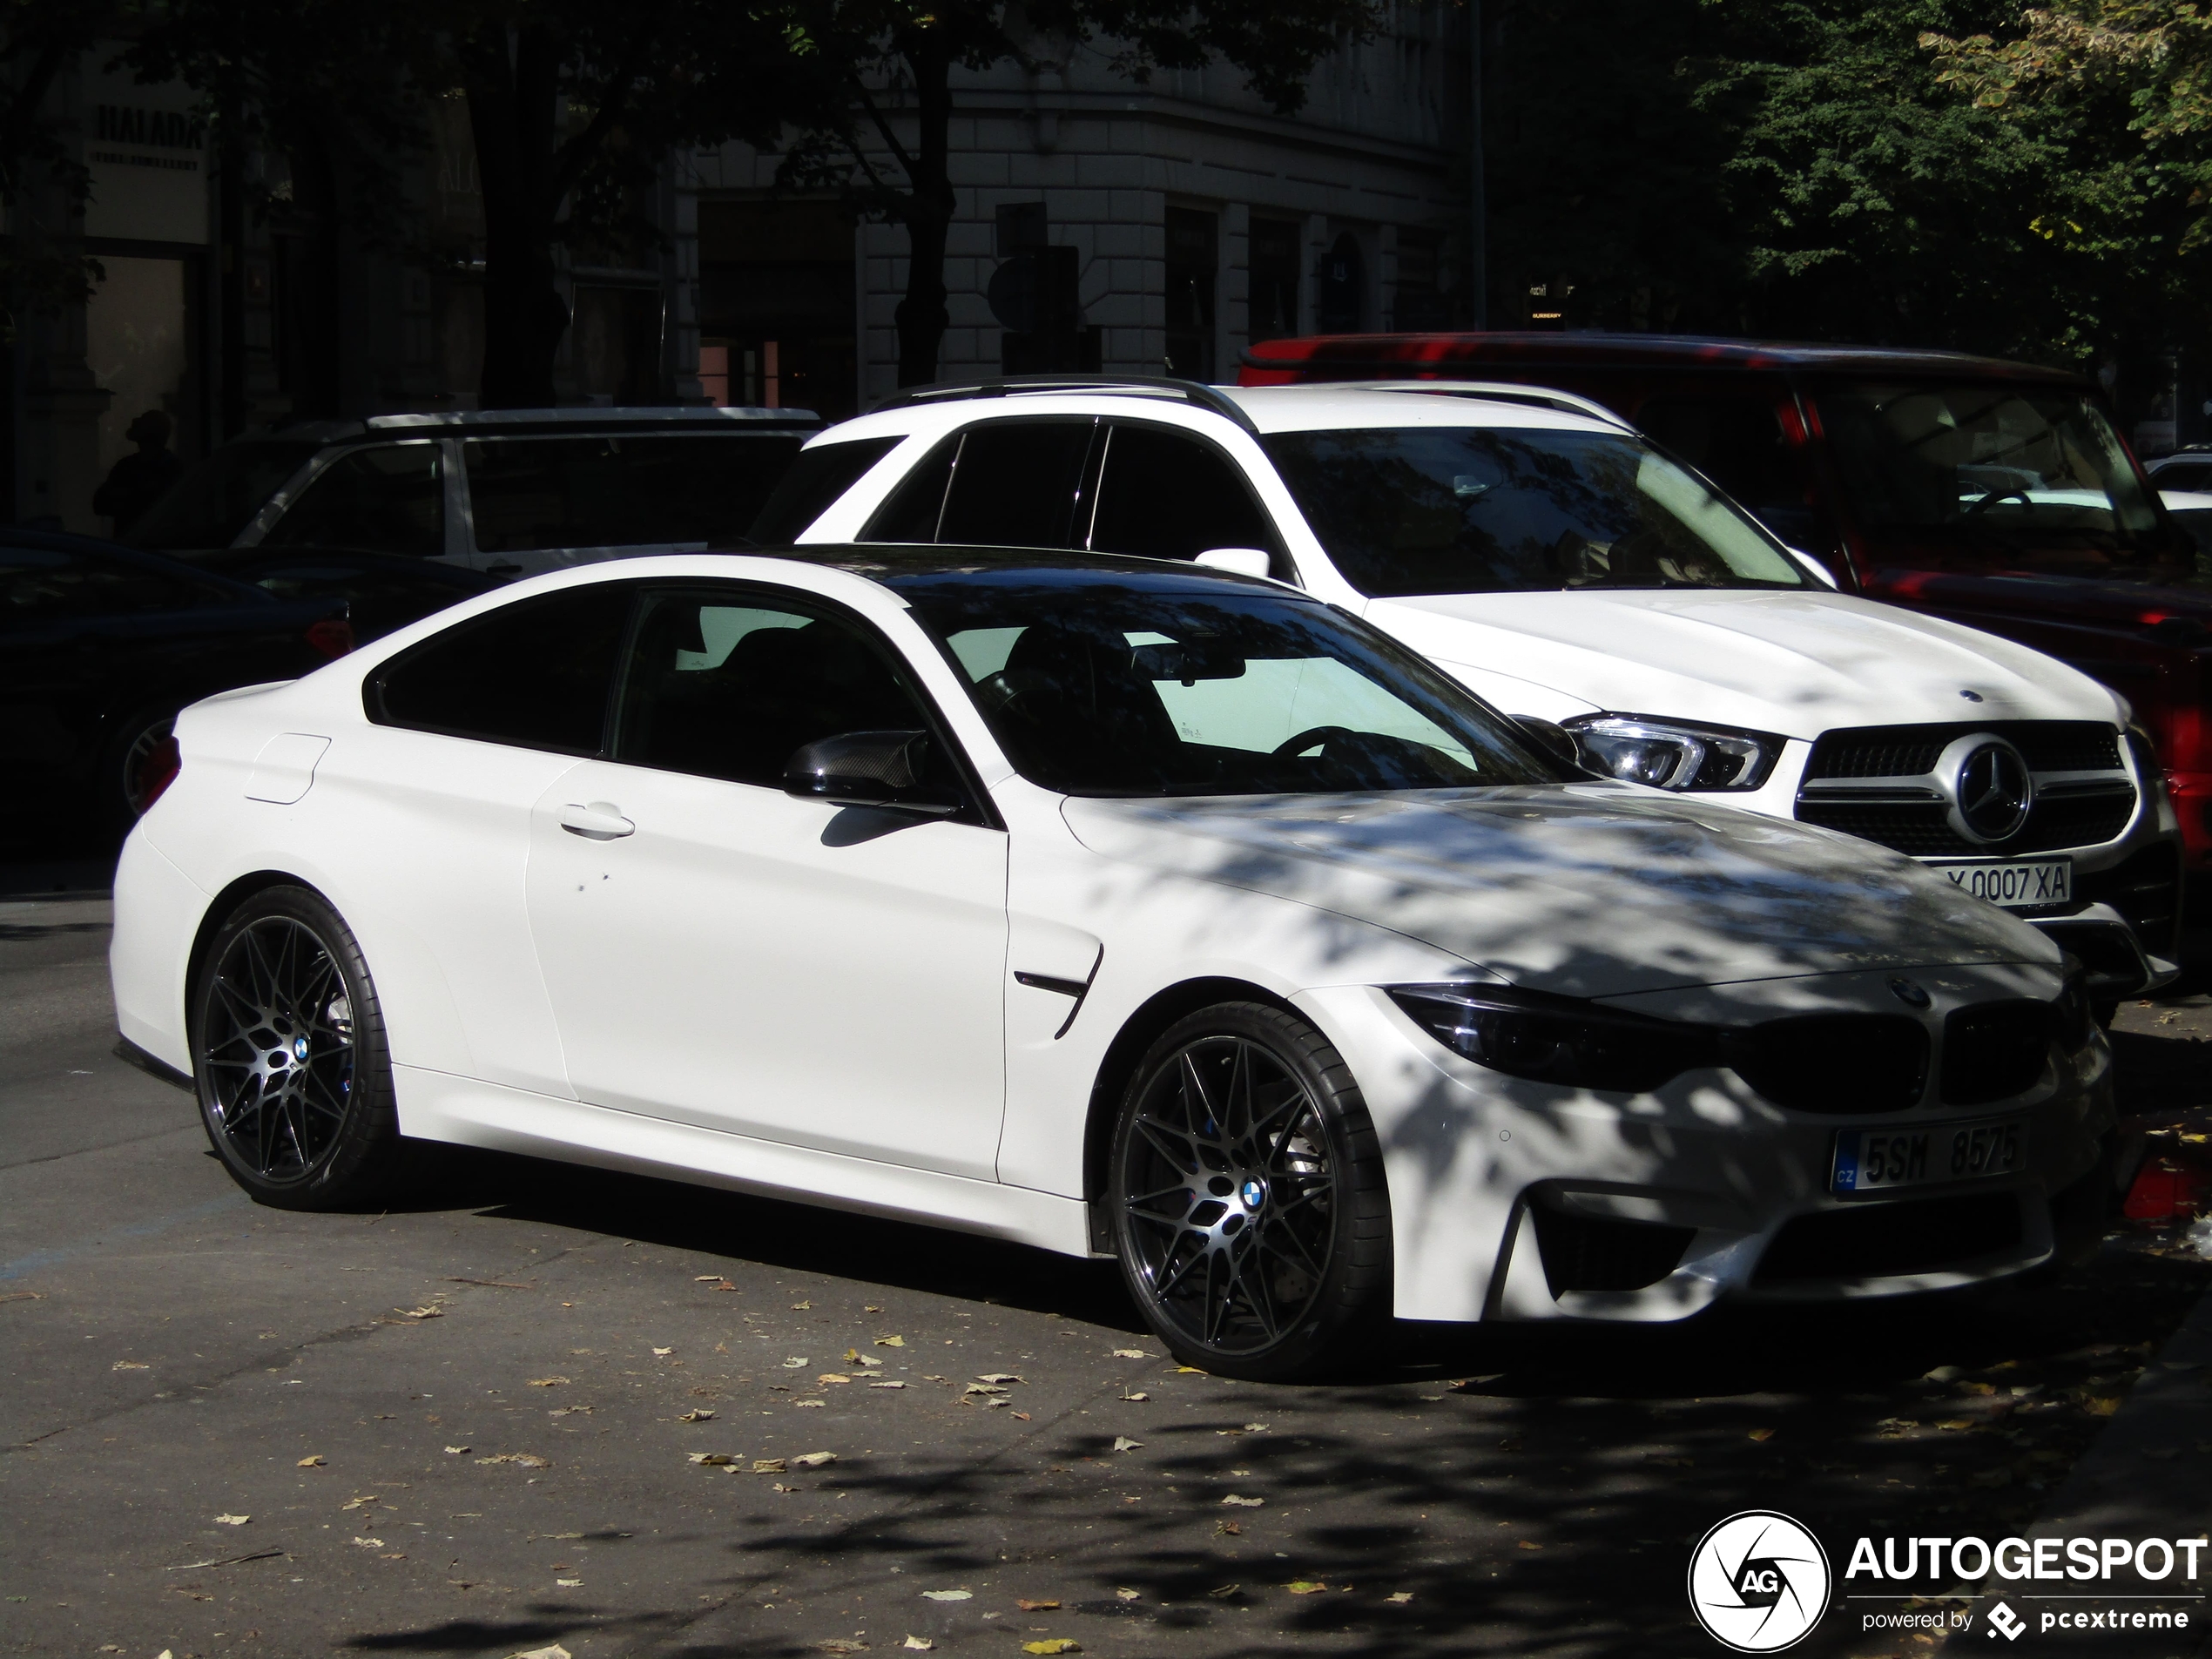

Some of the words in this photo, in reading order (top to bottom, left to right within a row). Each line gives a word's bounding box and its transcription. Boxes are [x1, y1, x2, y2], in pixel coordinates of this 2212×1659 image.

[1972, 868, 2029, 901] 0007
[2035, 867, 2066, 899] XA
[1865, 1134, 1929, 1183] 5SM
[1951, 1123, 2020, 1174] 8575
[1837, 1170, 1854, 1184] CZ
